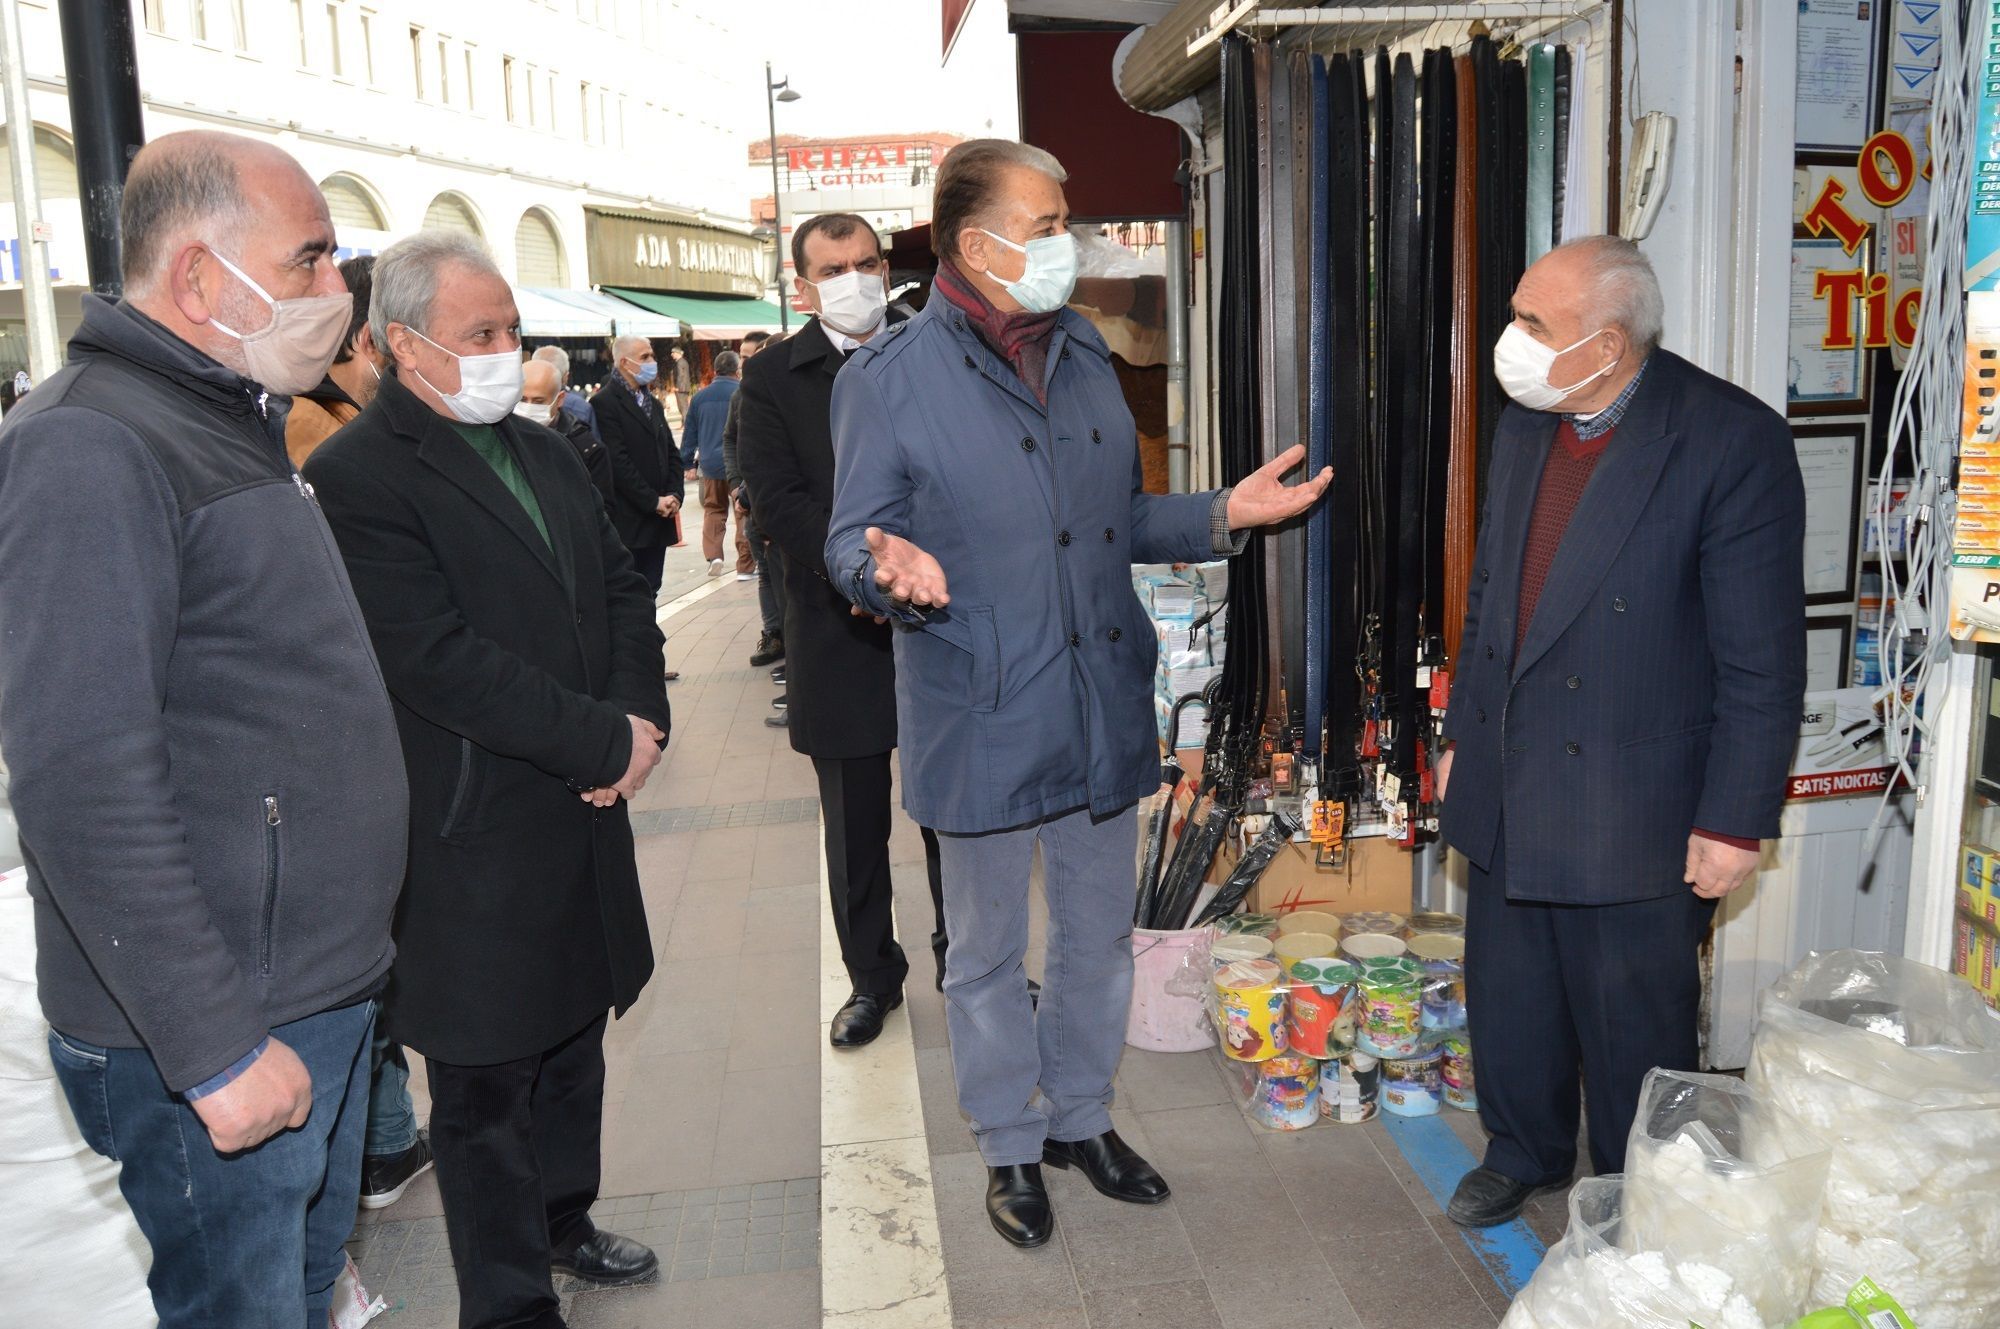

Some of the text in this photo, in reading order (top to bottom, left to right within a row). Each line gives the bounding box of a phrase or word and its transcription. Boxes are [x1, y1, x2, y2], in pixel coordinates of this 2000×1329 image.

[1804, 129, 1933, 258] TO
[635, 233, 671, 267] ADA
[1956, 555, 1992, 564] DERBY
[1793, 771, 1887, 794] SATIŞ NOKTAS
